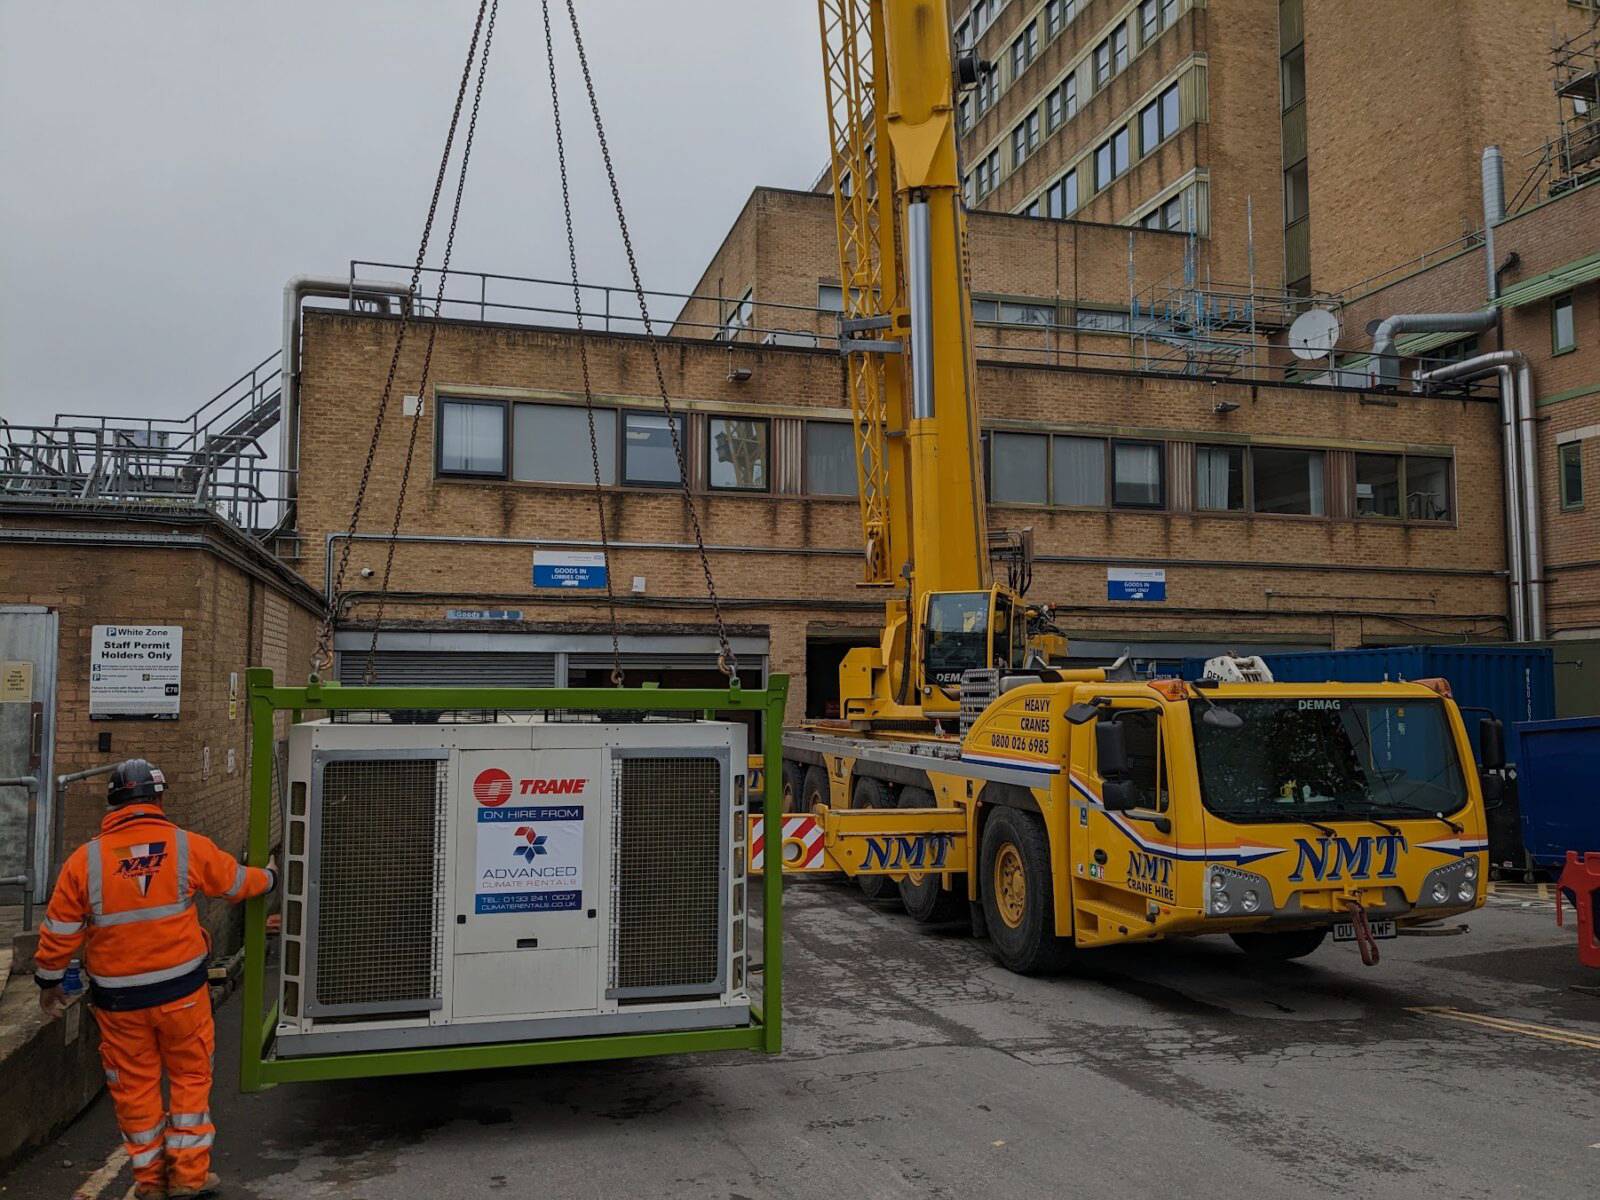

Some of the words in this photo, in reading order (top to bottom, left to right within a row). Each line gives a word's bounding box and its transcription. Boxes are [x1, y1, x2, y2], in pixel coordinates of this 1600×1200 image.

[101, 651, 144, 659] Holders
[148, 651, 172, 660] Only
[1024, 698, 1051, 712] HEAVY
[1298, 700, 1340, 710] DEMAG
[1020, 718, 1050, 733] CRANES
[992, 734, 1009, 748] 0800
[1012, 736, 1026, 751] 026
[1028, 738, 1049, 754] 6985
[520, 779, 586, 795] TRANE
[483, 811, 504, 820] ON
[507, 810, 537, 819] HIRE
[541, 809, 579, 818] FROM
[859, 836, 956, 870] NMT
[1289, 836, 1408, 881] NMT
[113, 853, 168, 874] NMT
[1127, 850, 1174, 886] NMT
[482, 866, 577, 879] ADVANCED
[1127, 878, 1152, 895] CRANE
[1155, 886, 1174, 900] HIRE
